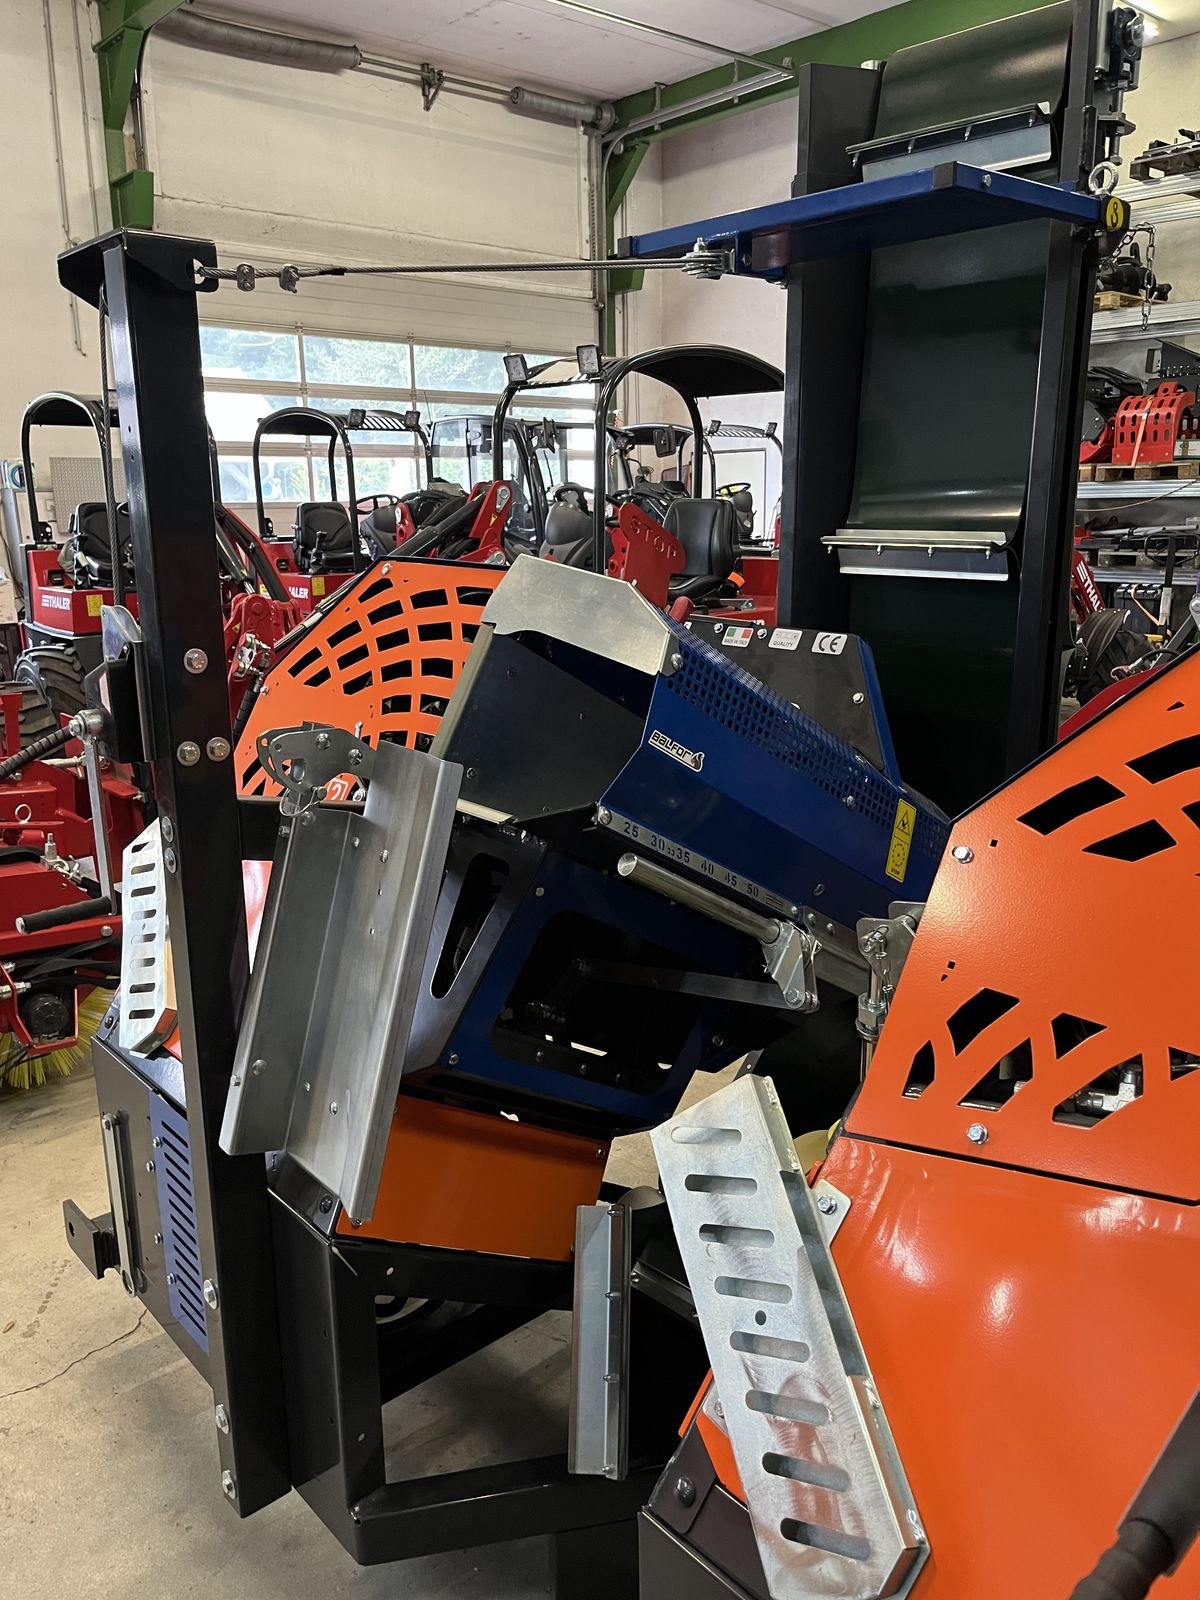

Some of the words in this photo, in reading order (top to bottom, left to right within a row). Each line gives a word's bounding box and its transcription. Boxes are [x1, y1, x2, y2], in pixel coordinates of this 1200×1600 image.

[630, 515, 680, 560] STOP
[818, 634, 842, 653] CE
[623, 821, 639, 838] 25
[650, 835, 665, 851] 30
[676, 847, 690, 864] 35
[700, 860, 714, 876] 40
[724, 872, 737, 888] 45
[746, 883, 759, 898] 50
